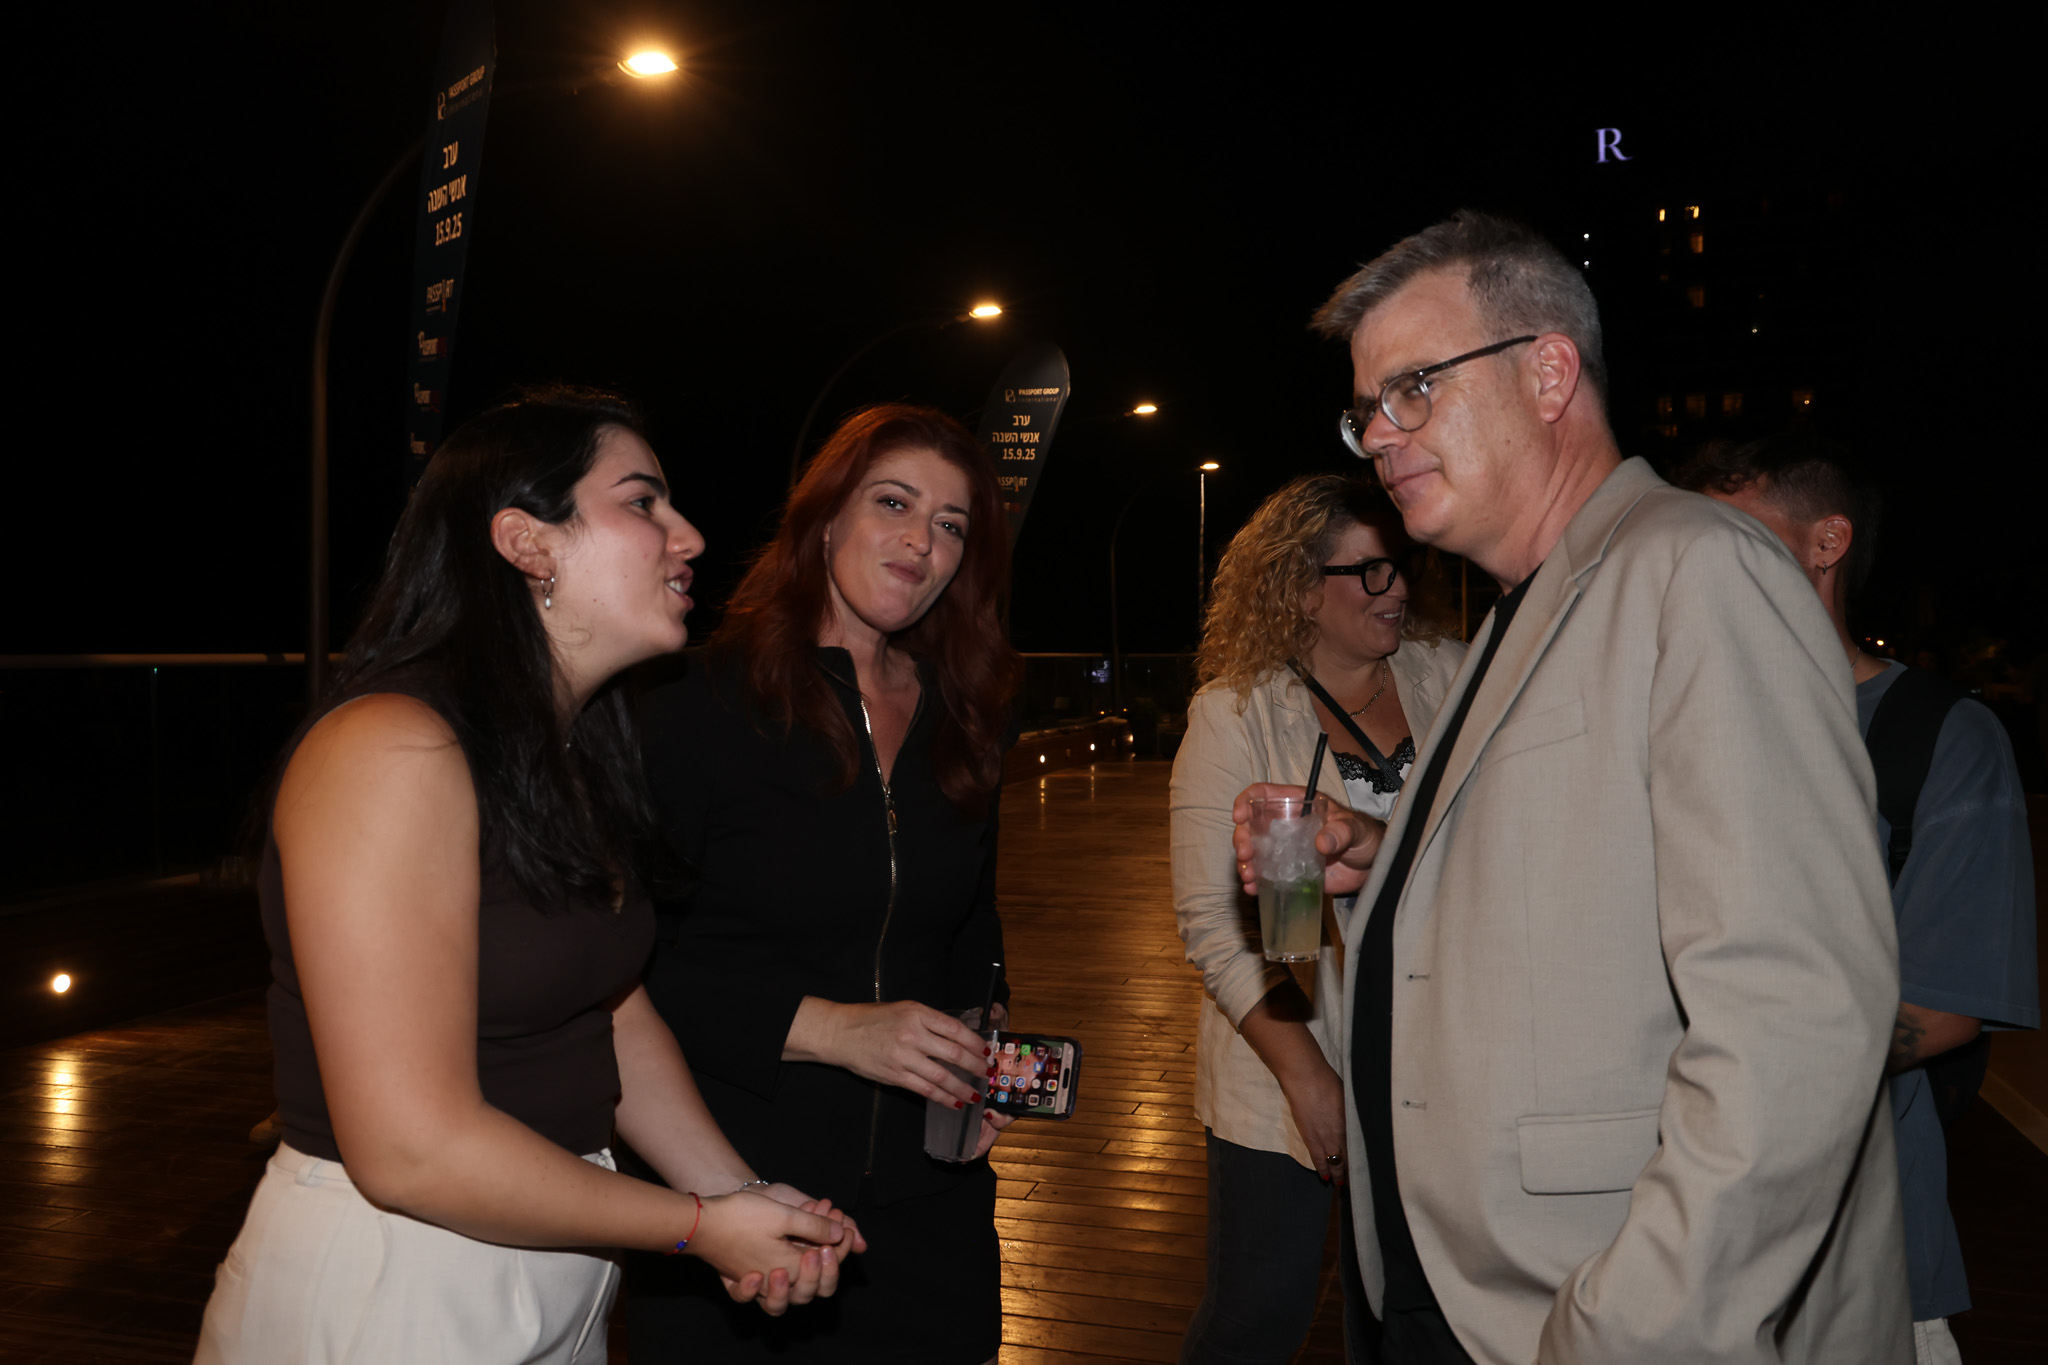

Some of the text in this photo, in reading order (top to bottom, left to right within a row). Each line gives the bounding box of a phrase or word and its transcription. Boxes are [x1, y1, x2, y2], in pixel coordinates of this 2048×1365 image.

[442, 140, 459, 170] ערב
[1594, 127, 1633, 163] R
[427, 174, 468, 214] אנשי השנה
[434, 211, 463, 247] 15.9.25
[1018, 388, 1043, 396] PASSPORT
[1043, 387, 1060, 395] GROUP
[1012, 414, 1031, 427] ערב
[992, 431, 1040, 443] אנשי השנה
[1002, 447, 1036, 461] 15.9.25
